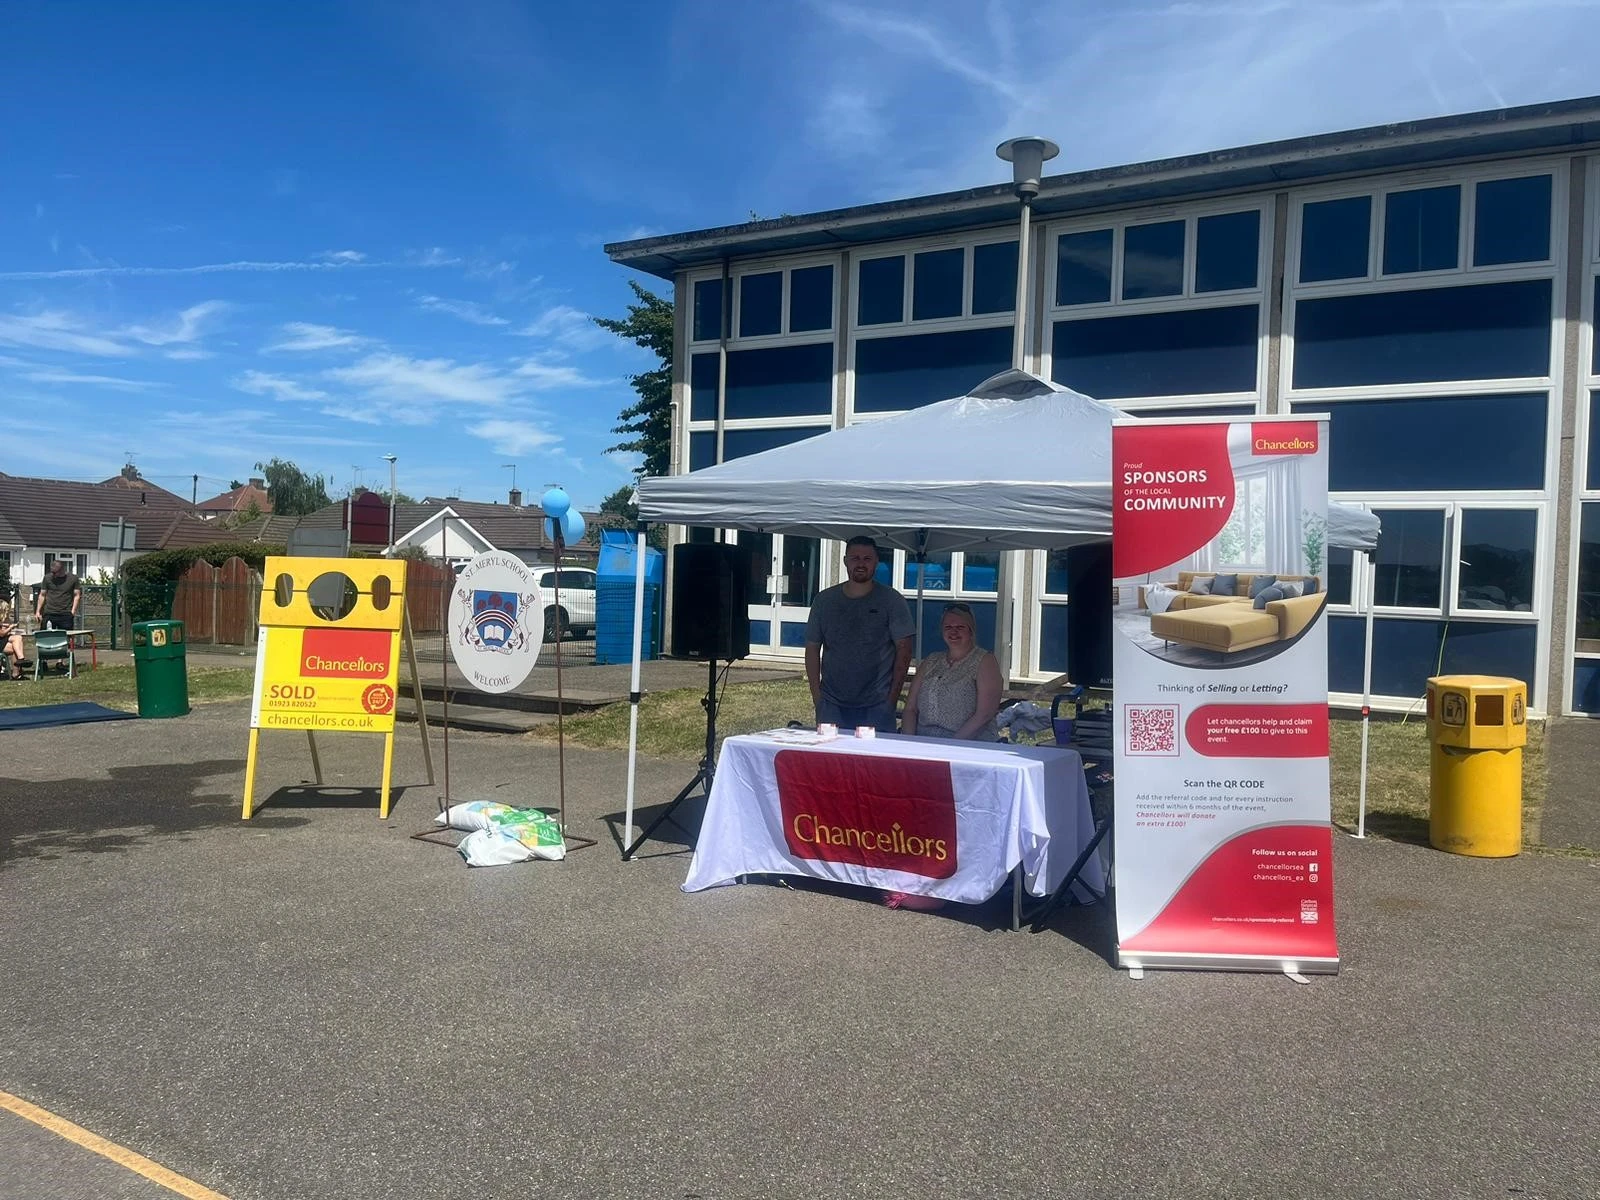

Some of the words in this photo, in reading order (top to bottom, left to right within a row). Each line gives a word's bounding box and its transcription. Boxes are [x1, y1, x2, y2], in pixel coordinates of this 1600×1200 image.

[1255, 437, 1315, 450] Chancellors
[1123, 462, 1143, 470] Proud
[1123, 469, 1207, 485] SPONSORS
[1124, 488, 1134, 496] OF
[1135, 488, 1149, 496] THE
[1123, 495, 1226, 511] COMMUNITY
[475, 557, 500, 571] MERYL
[501, 558, 529, 584] SCHOOL
[305, 655, 385, 673] Chancellors
[474, 670, 511, 687] WELCOME
[270, 684, 316, 700] SOLD
[1157, 684, 1195, 694] Thinking
[1196, 684, 1206, 693] of
[1207, 684, 1238, 694] Selling
[1239, 685, 1250, 693] or
[1251, 684, 1289, 694] Letting?
[269, 700, 291, 708] 01923
[291, 701, 317, 709] 820522
[267, 713, 374, 728] chancellors.co.uk
[1207, 718, 1219, 726] Let
[1219, 718, 1261, 726] chancellors
[1262, 718, 1278, 727] help
[1279, 718, 1293, 726] and
[1294, 718, 1313, 726] claim
[1207, 727, 1223, 736] your
[1224, 726, 1240, 735] free
[1241, 726, 1260, 735] £100
[1261, 727, 1269, 735] to
[1270, 727, 1286, 736] give
[1286, 727, 1294, 735] to
[1295, 727, 1308, 735] this
[1207, 736, 1229, 744] event.
[1183, 779, 1206, 788] Scan
[1207, 779, 1222, 788] the
[1224, 780, 1239, 789] QR
[1239, 780, 1265, 789] CODE
[1164, 794, 1190, 802] referral
[1235, 796, 1255, 804] every
[1255, 795, 1294, 803] instruction
[1195, 803, 1221, 811] months
[1222, 803, 1232, 811] of
[1244, 805, 1267, 813] event,
[1191, 812, 1216, 820] donate
[793, 813, 947, 861] Chancellors
[1252, 848, 1276, 856] Follow
[1297, 849, 1318, 857] social
[1257, 863, 1304, 871] chancellorsea
[1253, 874, 1304, 883] chancellors_ea
